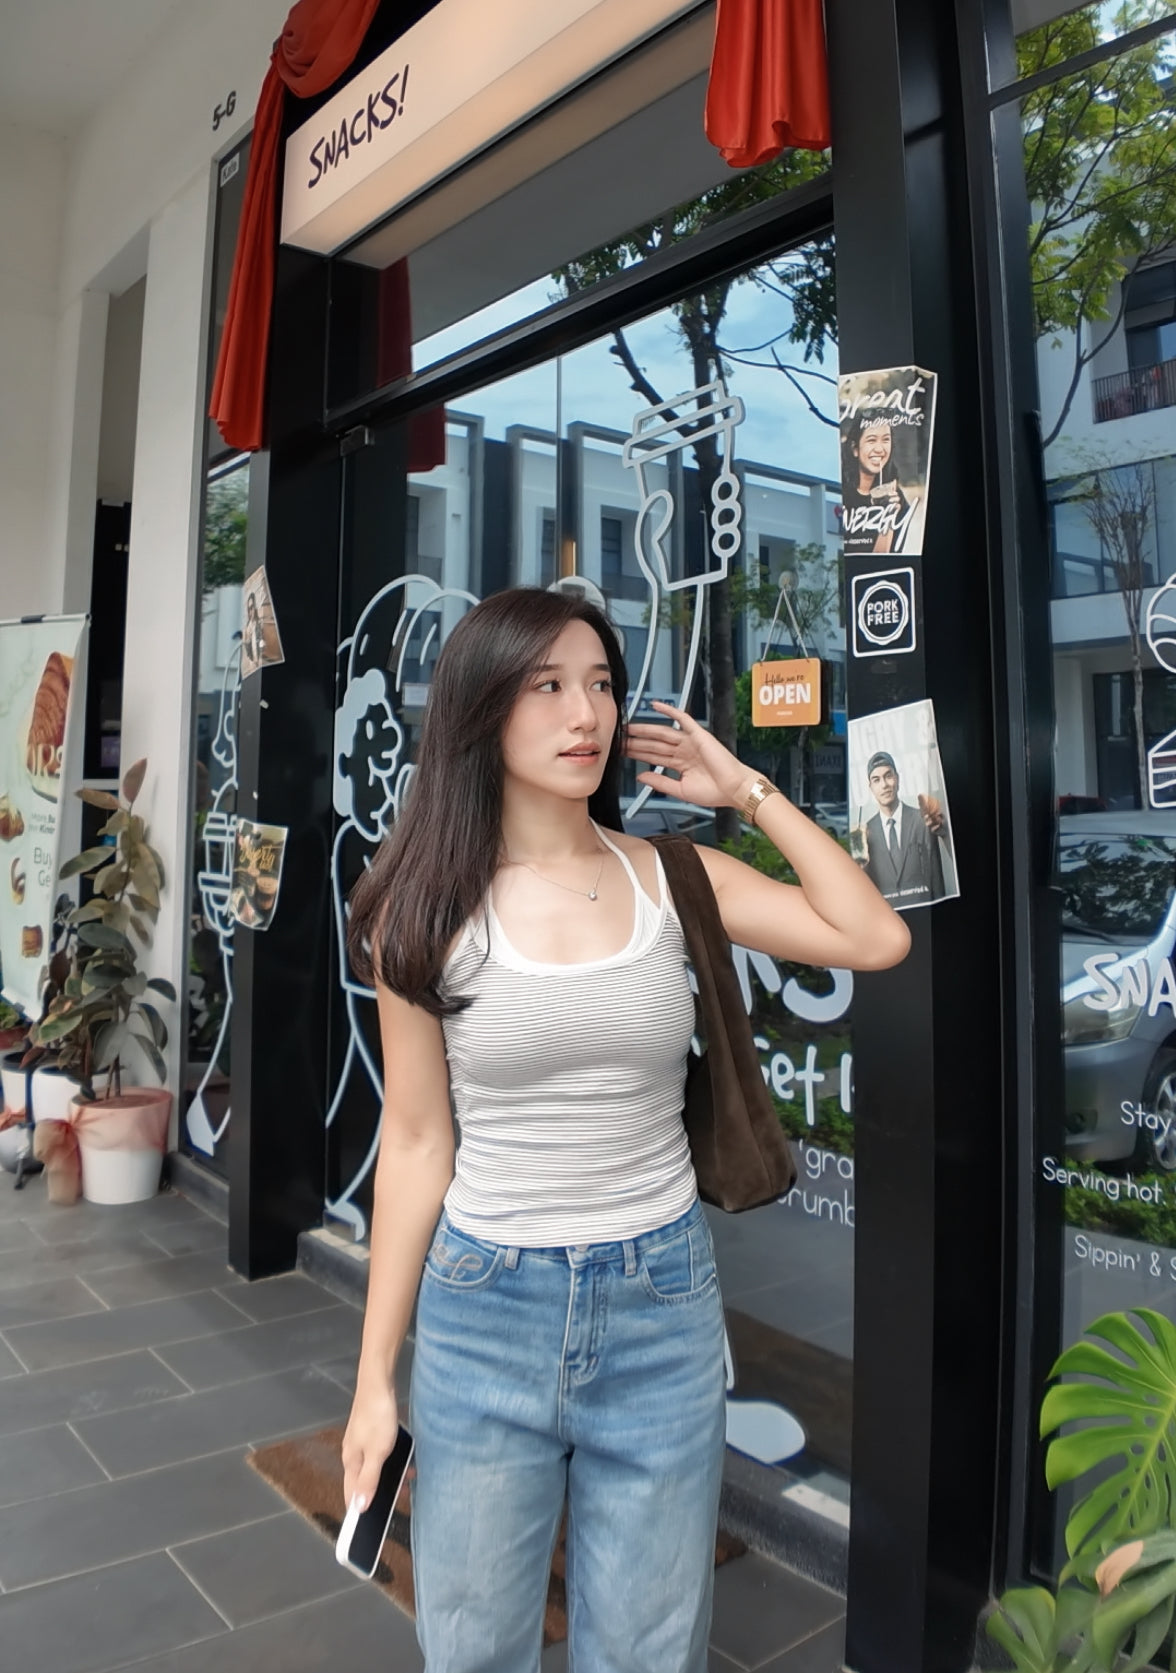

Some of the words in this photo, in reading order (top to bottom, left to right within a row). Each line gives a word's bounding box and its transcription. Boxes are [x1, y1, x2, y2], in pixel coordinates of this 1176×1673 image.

[308, 64, 409, 189] SNACKS!
[860, 414, 925, 429] moments
[842, 497, 919, 552] NERGY
[867, 599, 899, 615] PORK
[867, 611, 900, 627] FREE
[759, 683, 811, 706] OPEN
[1083, 952, 1176, 1018] SNA
[753, 1036, 825, 1126] et
[1120, 1100, 1171, 1137] Stay
[1042, 1156, 1120, 1201] Serving
[777, 1188, 855, 1228] rumb
[1149, 1251, 1161, 1277] &
